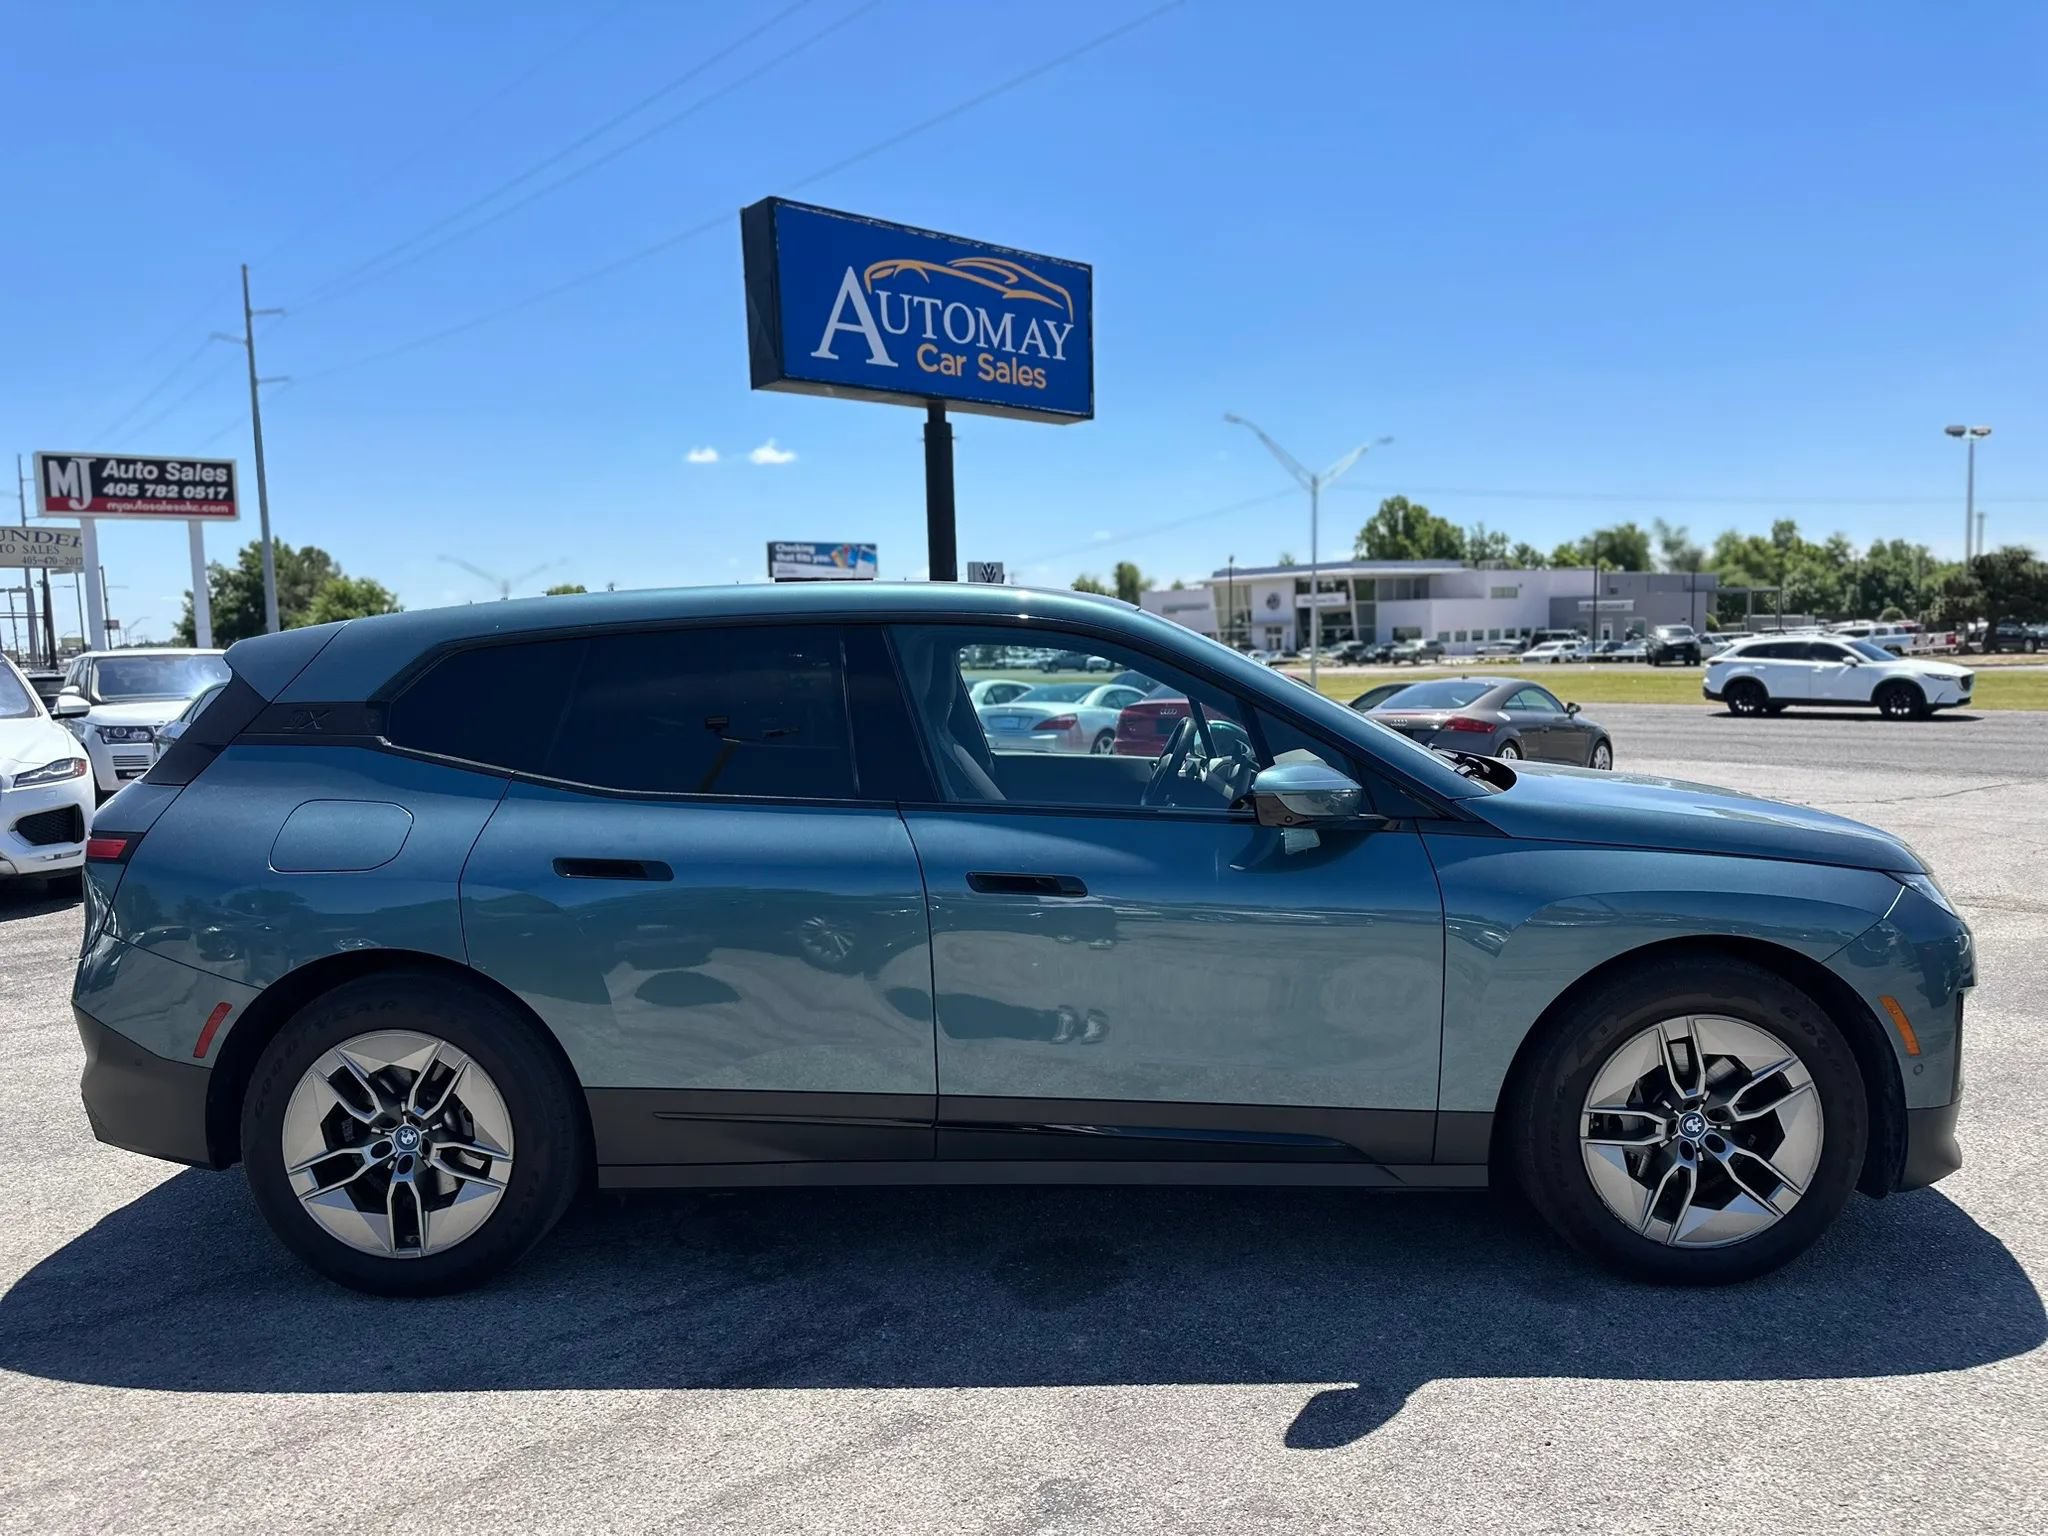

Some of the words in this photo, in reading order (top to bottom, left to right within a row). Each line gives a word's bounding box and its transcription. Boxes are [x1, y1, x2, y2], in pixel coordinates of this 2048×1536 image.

[917, 343, 967, 377] Car
[978, 353, 1047, 389] Sales
[101, 460, 159, 480] Auto
[165, 462, 228, 482] Sales
[48, 457, 97, 510] MJ
[103, 482, 139, 497] 405
[144, 484, 179, 498] 782
[183, 486, 229, 500] 0517
[22, 545, 60, 555] SALES
